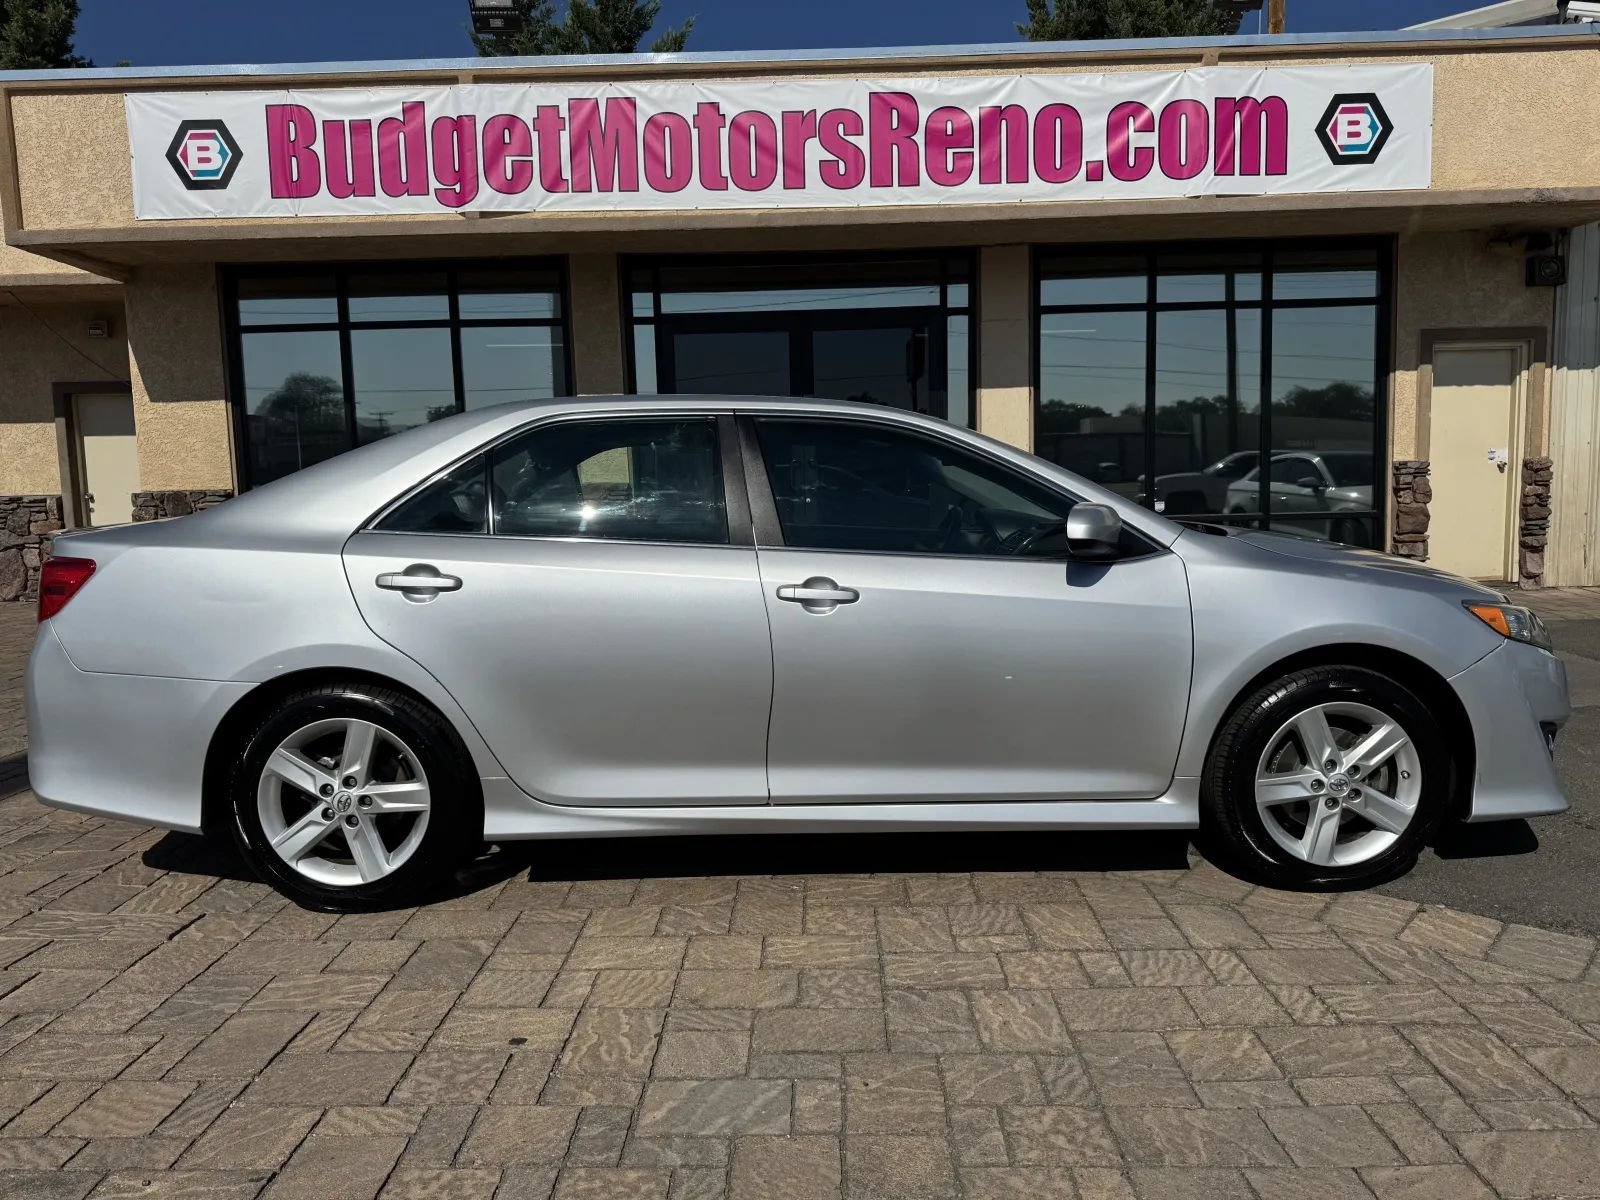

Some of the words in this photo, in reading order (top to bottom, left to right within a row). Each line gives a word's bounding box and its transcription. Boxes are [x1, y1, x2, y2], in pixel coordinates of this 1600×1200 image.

[1336, 113, 1373, 145] B
[187, 139, 223, 171] B
[265, 92, 1288, 208] BudgetMotorsReno.com
